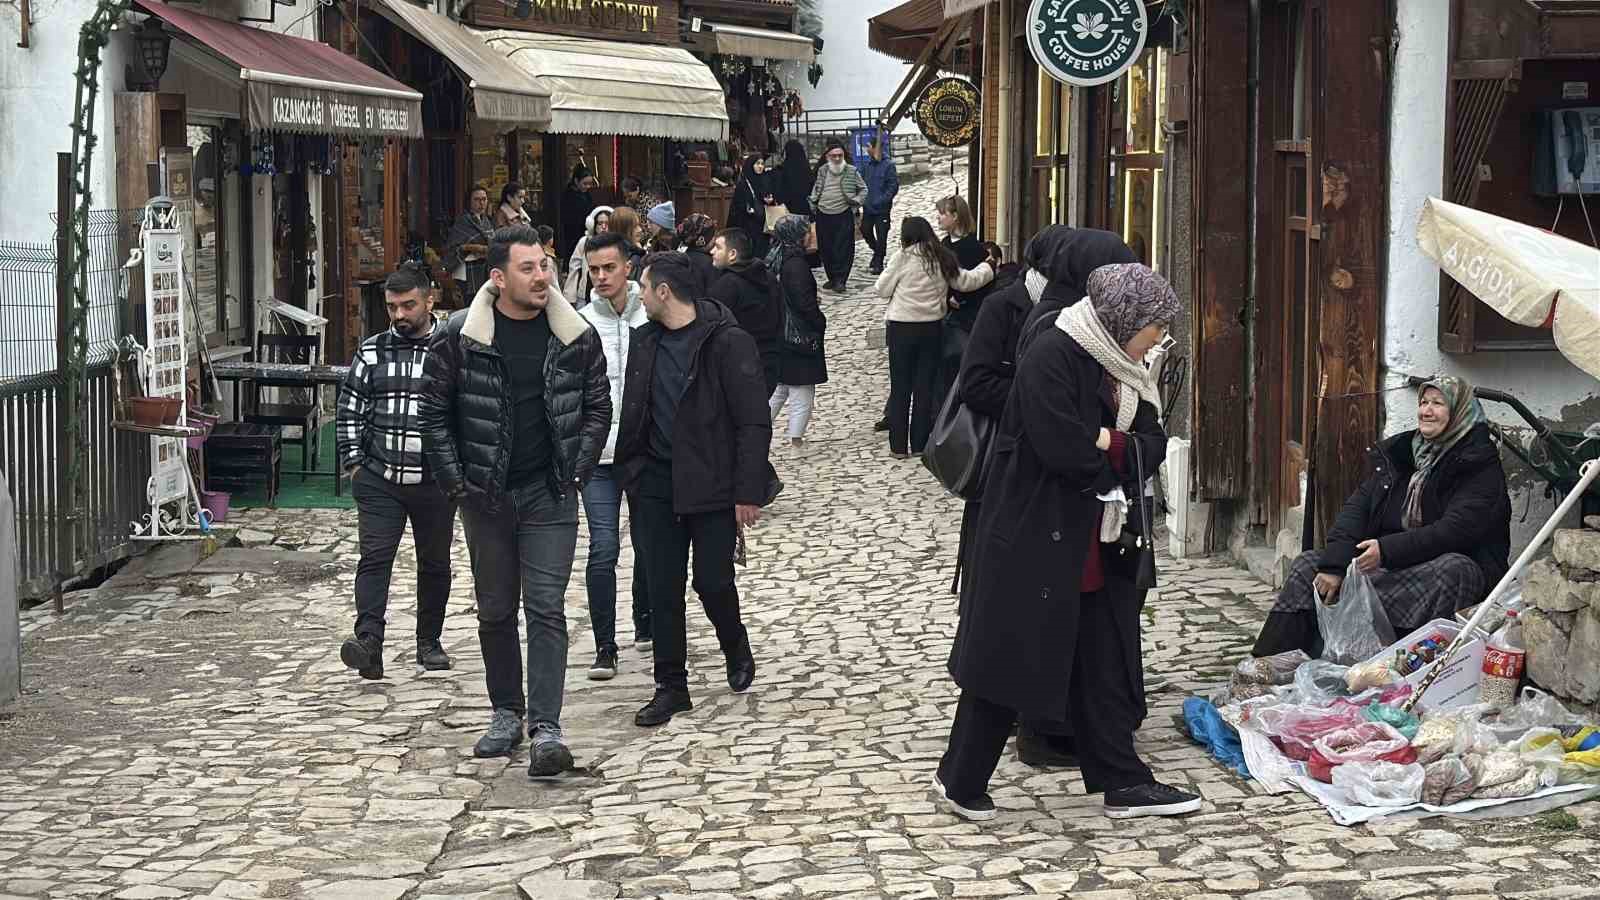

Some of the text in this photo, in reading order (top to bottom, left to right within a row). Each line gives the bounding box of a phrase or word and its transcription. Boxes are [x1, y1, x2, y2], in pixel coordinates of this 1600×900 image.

[1048, 35, 1132, 71] COFFEE HOUSE
[329, 98, 361, 128] YÖRESEL
[365, 106, 375, 129] EV
